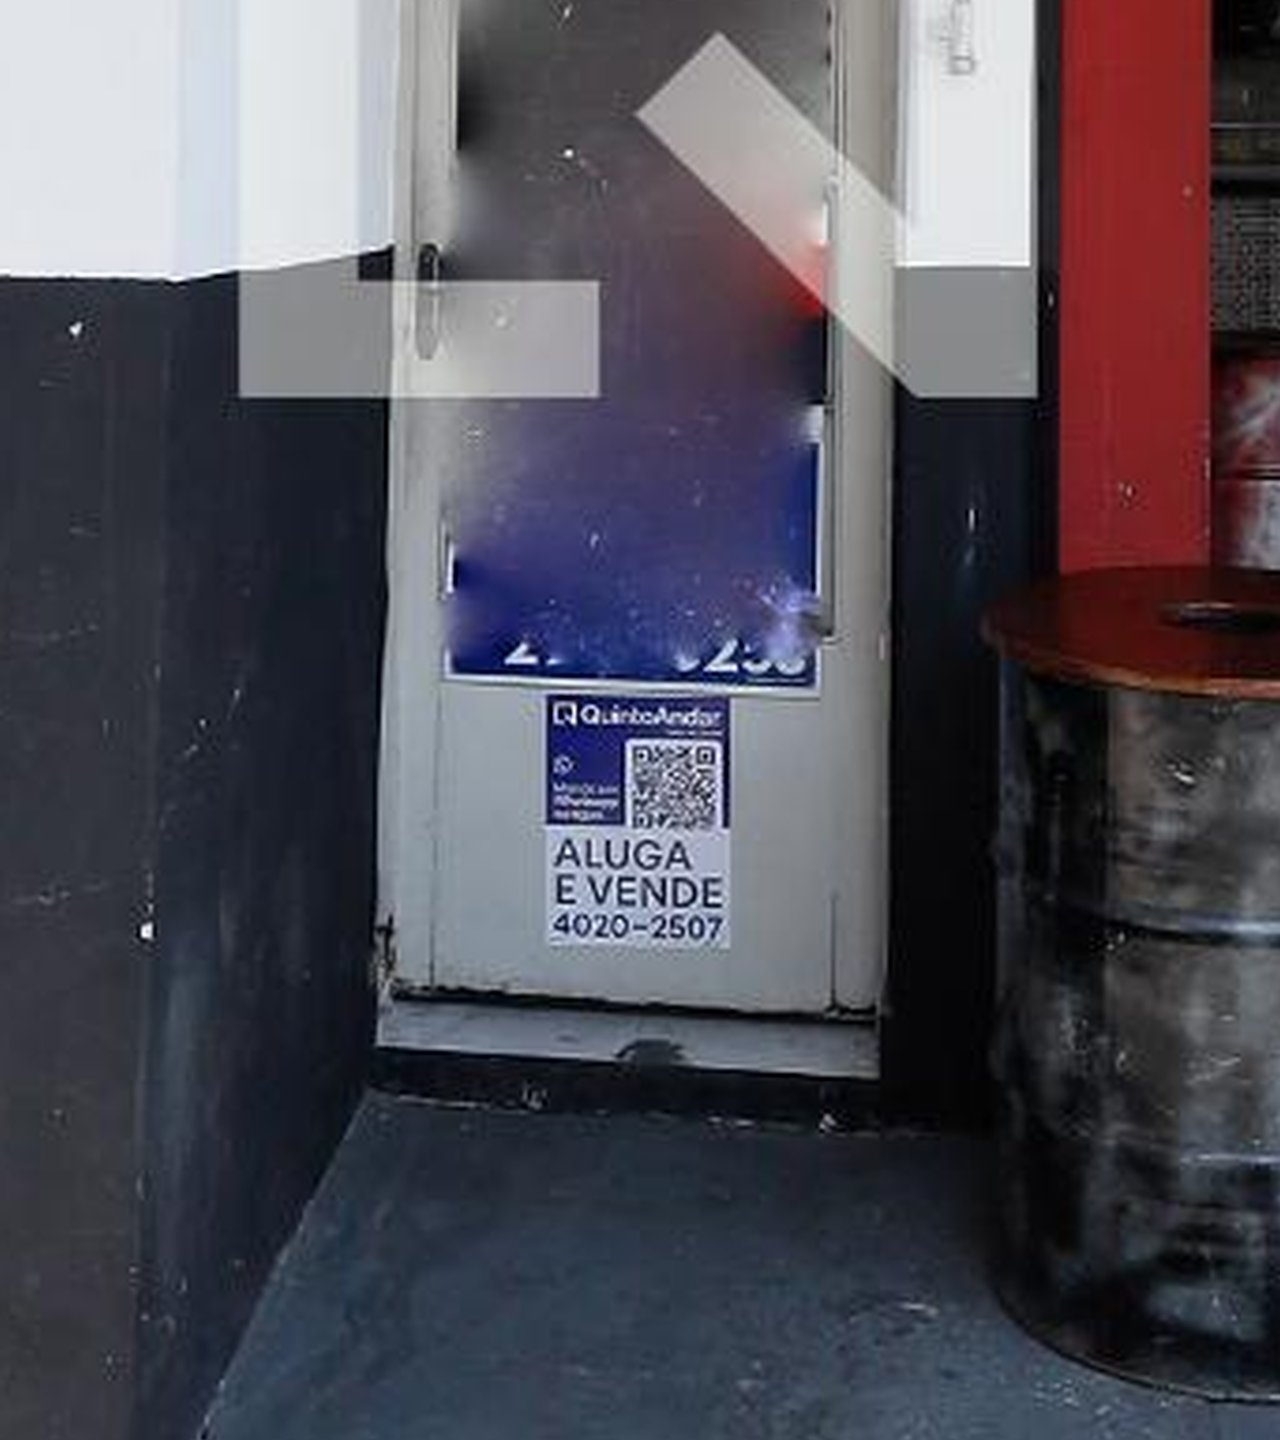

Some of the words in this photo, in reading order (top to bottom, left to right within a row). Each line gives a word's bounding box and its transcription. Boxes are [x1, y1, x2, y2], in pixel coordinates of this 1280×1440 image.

[580, 703, 723, 727] QuintoAndar
[553, 839, 692, 869] ALUGA
[555, 875, 576, 905] E
[589, 876, 724, 909] VENDE
[553, 914, 724, 940] 4020-2507
